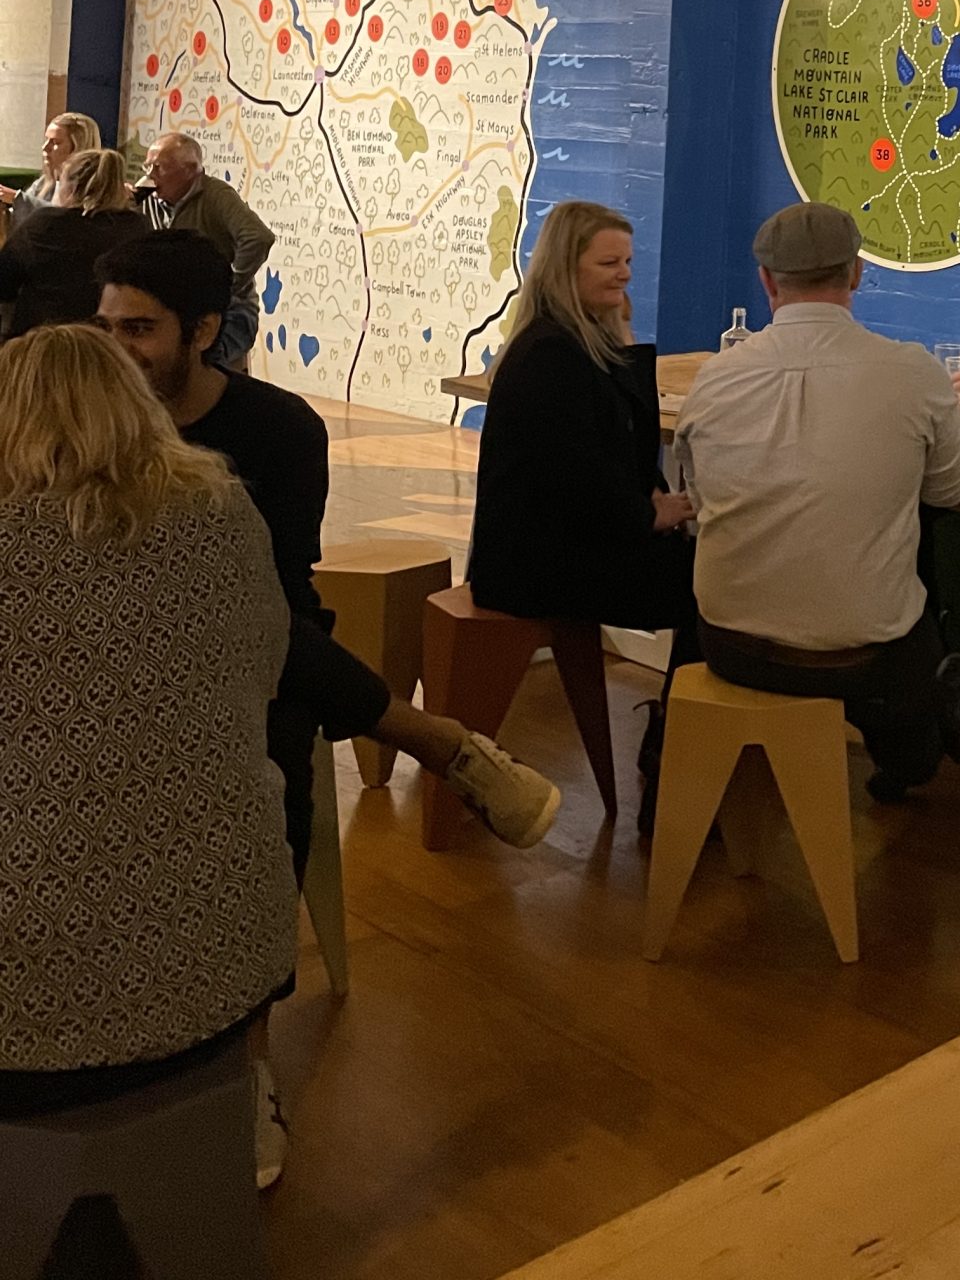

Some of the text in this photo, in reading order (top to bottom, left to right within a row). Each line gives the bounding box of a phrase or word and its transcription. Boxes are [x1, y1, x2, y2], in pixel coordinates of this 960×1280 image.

[481, 43, 523, 57] St Helens
[803, 48, 850, 65] CRADLE
[340, 47, 363, 82] TASMAN
[349, 47, 374, 86] HIGHWAY
[438, 65, 448, 75] 20
[466, 90, 519, 104] Scamander
[783, 84, 813, 99] LAKE
[819, 87, 833, 103] ST
[836, 89, 869, 104] CLAIR
[793, 105, 861, 122] NATIONAL
[347, 130, 361, 141] BEN
[476, 119, 514, 140] St Marys
[805, 123, 838, 139] PARK
[329, 124, 346, 169] MIDLAND
[876, 148, 890, 161] 38
[213, 153, 244, 166] Meander
[358, 157, 375, 167] PARK
[437, 149, 461, 167] Fingal
[271, 170, 290, 185] Liffey
[422, 176, 467, 230] ESK HIGHWAY
[455, 229, 483, 241] APSLEY
[459, 258, 479, 270] PARK
[372, 279, 404, 297] Campbell
